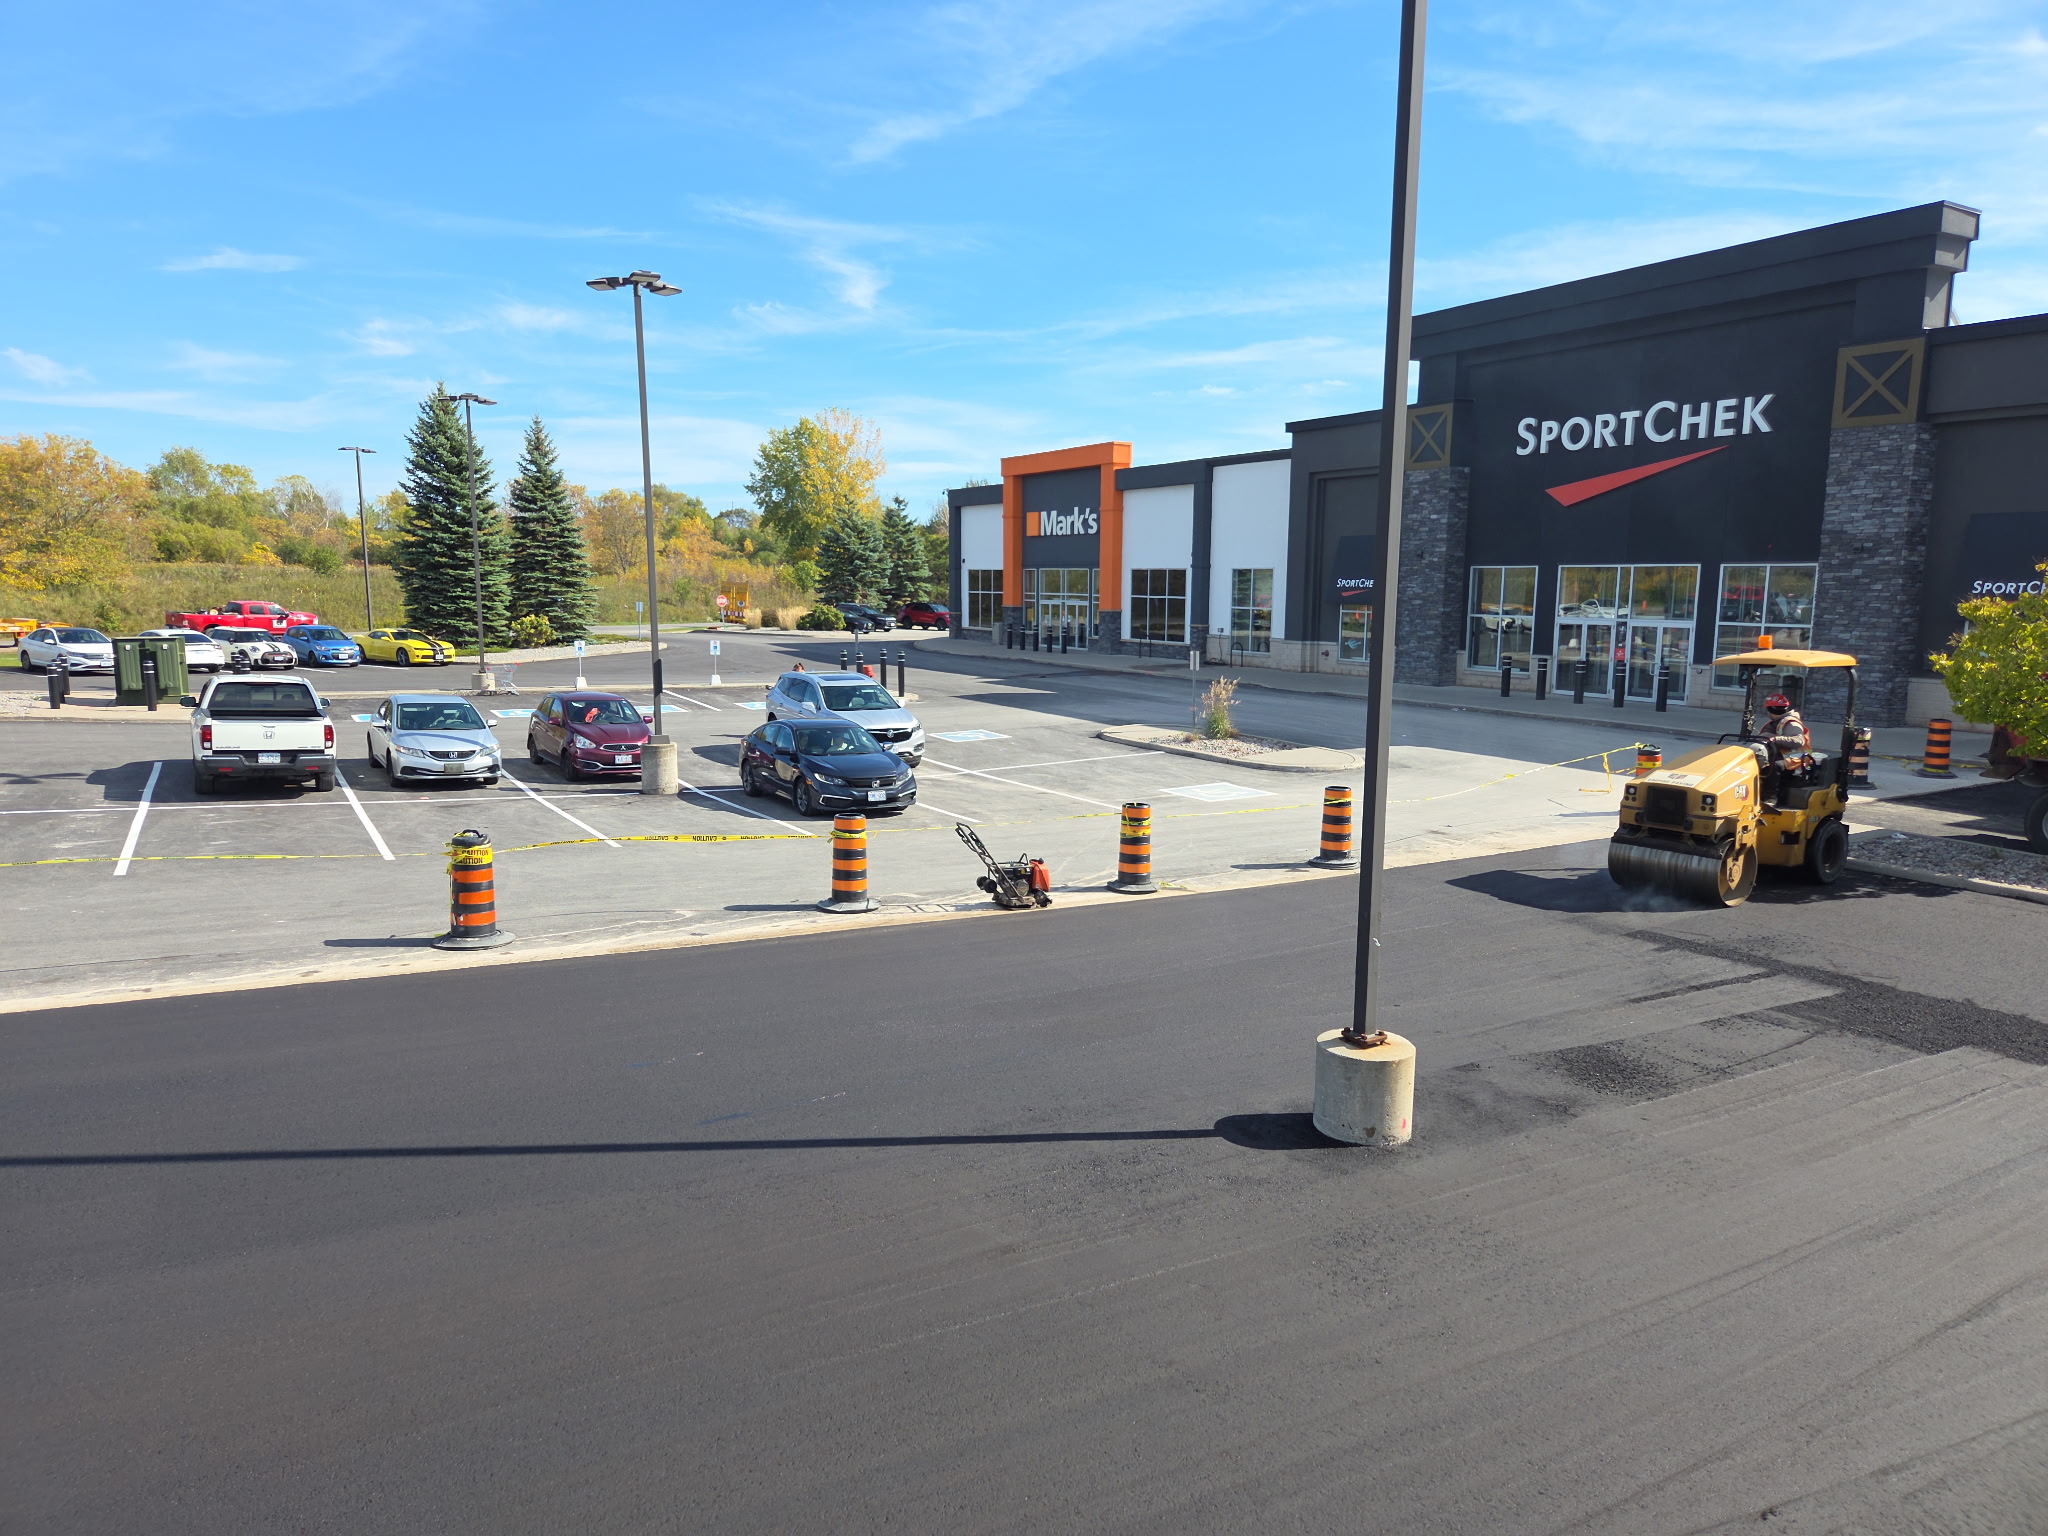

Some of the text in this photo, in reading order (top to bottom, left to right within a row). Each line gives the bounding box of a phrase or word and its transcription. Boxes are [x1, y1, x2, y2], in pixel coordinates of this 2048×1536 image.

[1516, 393, 1776, 456] SPORTCHEK
[1040, 506, 1098, 536] Mark's
[1336, 578, 1374, 588] SPORTCHE
[1972, 580, 2047, 594] SPORTC
